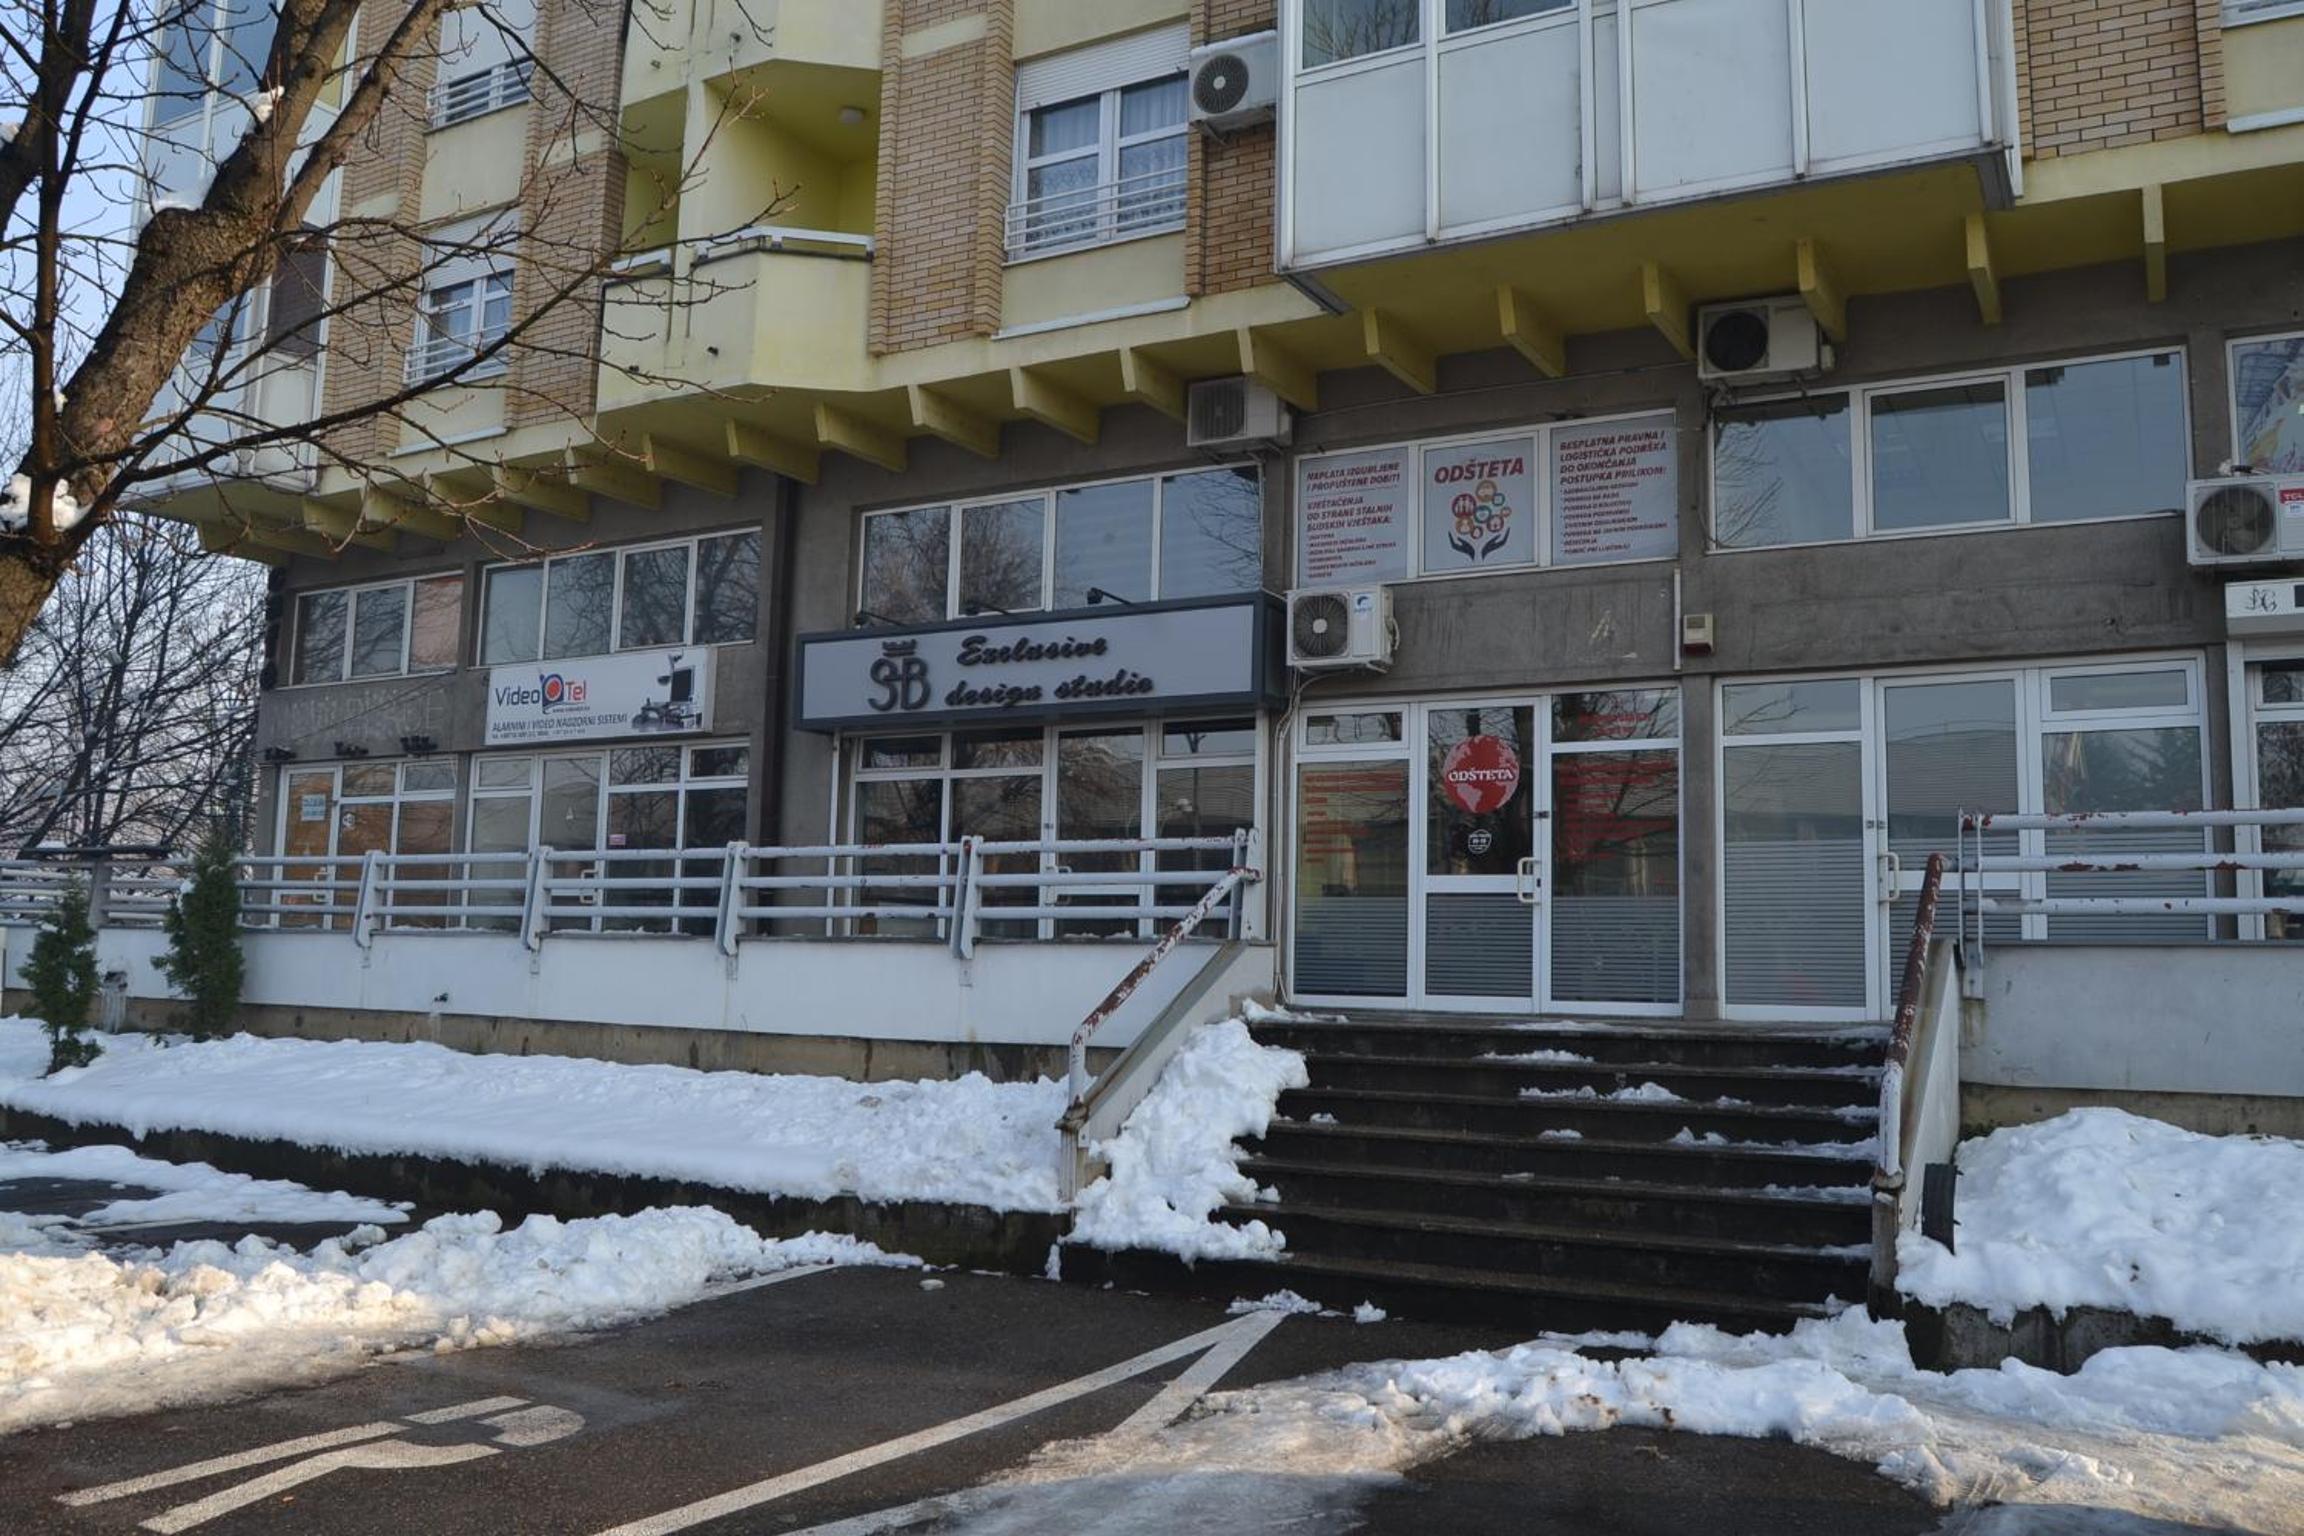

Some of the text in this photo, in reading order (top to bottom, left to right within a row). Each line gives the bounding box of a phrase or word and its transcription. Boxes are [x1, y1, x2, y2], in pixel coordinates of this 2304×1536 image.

[1560, 436, 1615, 450] BESPLATNA
[1617, 431, 1658, 445] PRAVNA
[1560, 441, 1667, 462] LOGISTIČKA PODRŠKA
[1434, 457, 1524, 484] ODŠTETA
[1560, 457, 1637, 474] DO OKONČANJA
[1307, 469, 1344, 481] NAPLATA
[1560, 472, 1612, 486] POSTUPKA
[1307, 512, 1320, 521] OD
[1321, 508, 1354, 520] STRANE
[956, 634, 1108, 667] Exclusive
[495, 680, 587, 707] Video Tel
[944, 667, 1155, 708] design studio
[597, 713, 628, 726] SISTEMI
[1448, 767, 1515, 782] ODŠTETA
